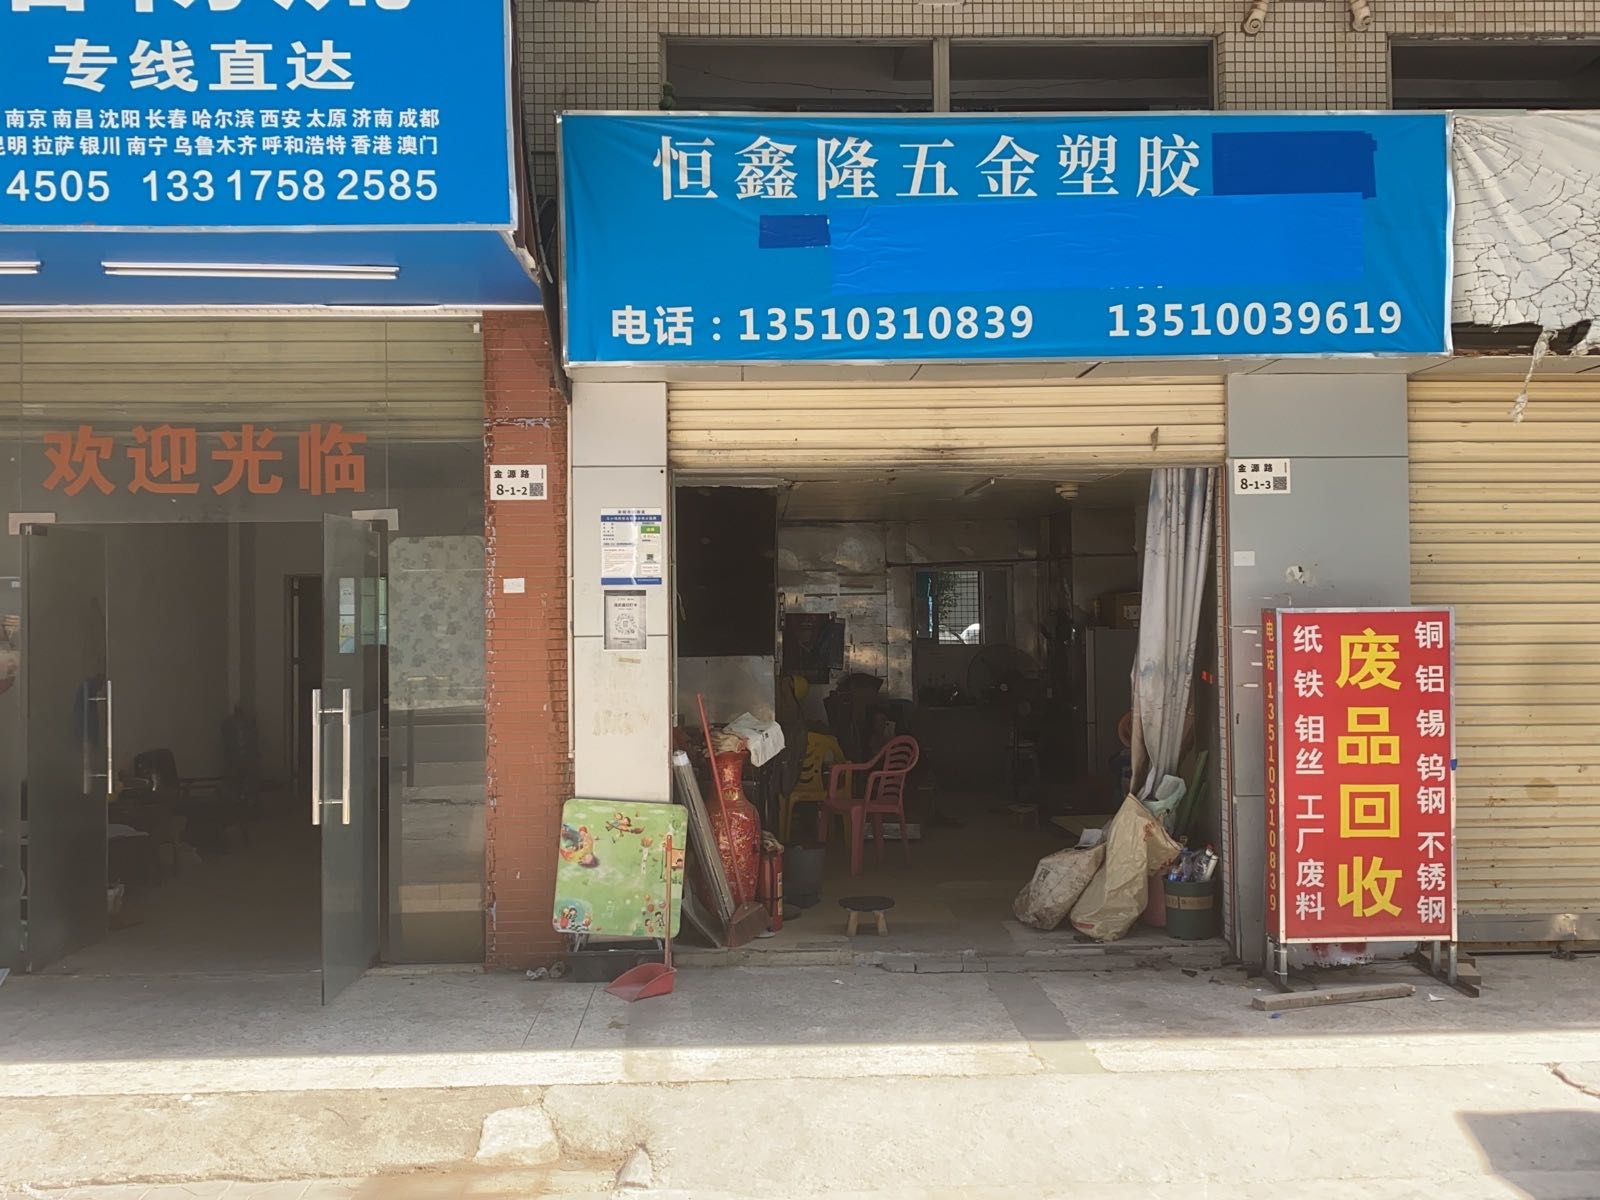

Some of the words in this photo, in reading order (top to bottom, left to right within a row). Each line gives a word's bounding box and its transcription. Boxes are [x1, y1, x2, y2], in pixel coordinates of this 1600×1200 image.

[48, 38, 355, 93] 专线直达
[5, 108, 47, 130] 南京
[52, 108, 94, 130] 南昌
[99, 108, 140, 130] 沈阳
[145, 108, 187, 130] 长春
[192, 108, 255, 130] 哈尔滨
[259, 108, 301, 130] 西安
[306, 108, 347, 130] 太原
[352, 108, 394, 130] 济南
[398, 108, 440, 130] 成都
[32, 135, 74, 156] 拉萨
[79, 135, 120, 156] 银川
[126, 135, 168, 156] 南宁
[174, 135, 257, 156] 乌鲁木齐
[262, 135, 346, 156] 呼和浩特
[351, 135, 392, 156] 香港
[397, 135, 438, 156] 澳门
[652, 133, 1201, 201] 恒鑫隆五金塑胶
[6, 169, 110, 203] 4505
[1108, 300, 1403, 338] 13510039619
[43, 423, 368, 497] 欢迎光临
[493, 469, 529, 479] 金源路
[1237, 463, 1273, 473] 金源路
[496, 483, 528, 496] 8-1-2
[1240, 478, 1271, 490] 8-1-3
[1335, 627, 1403, 918] 废品回收
